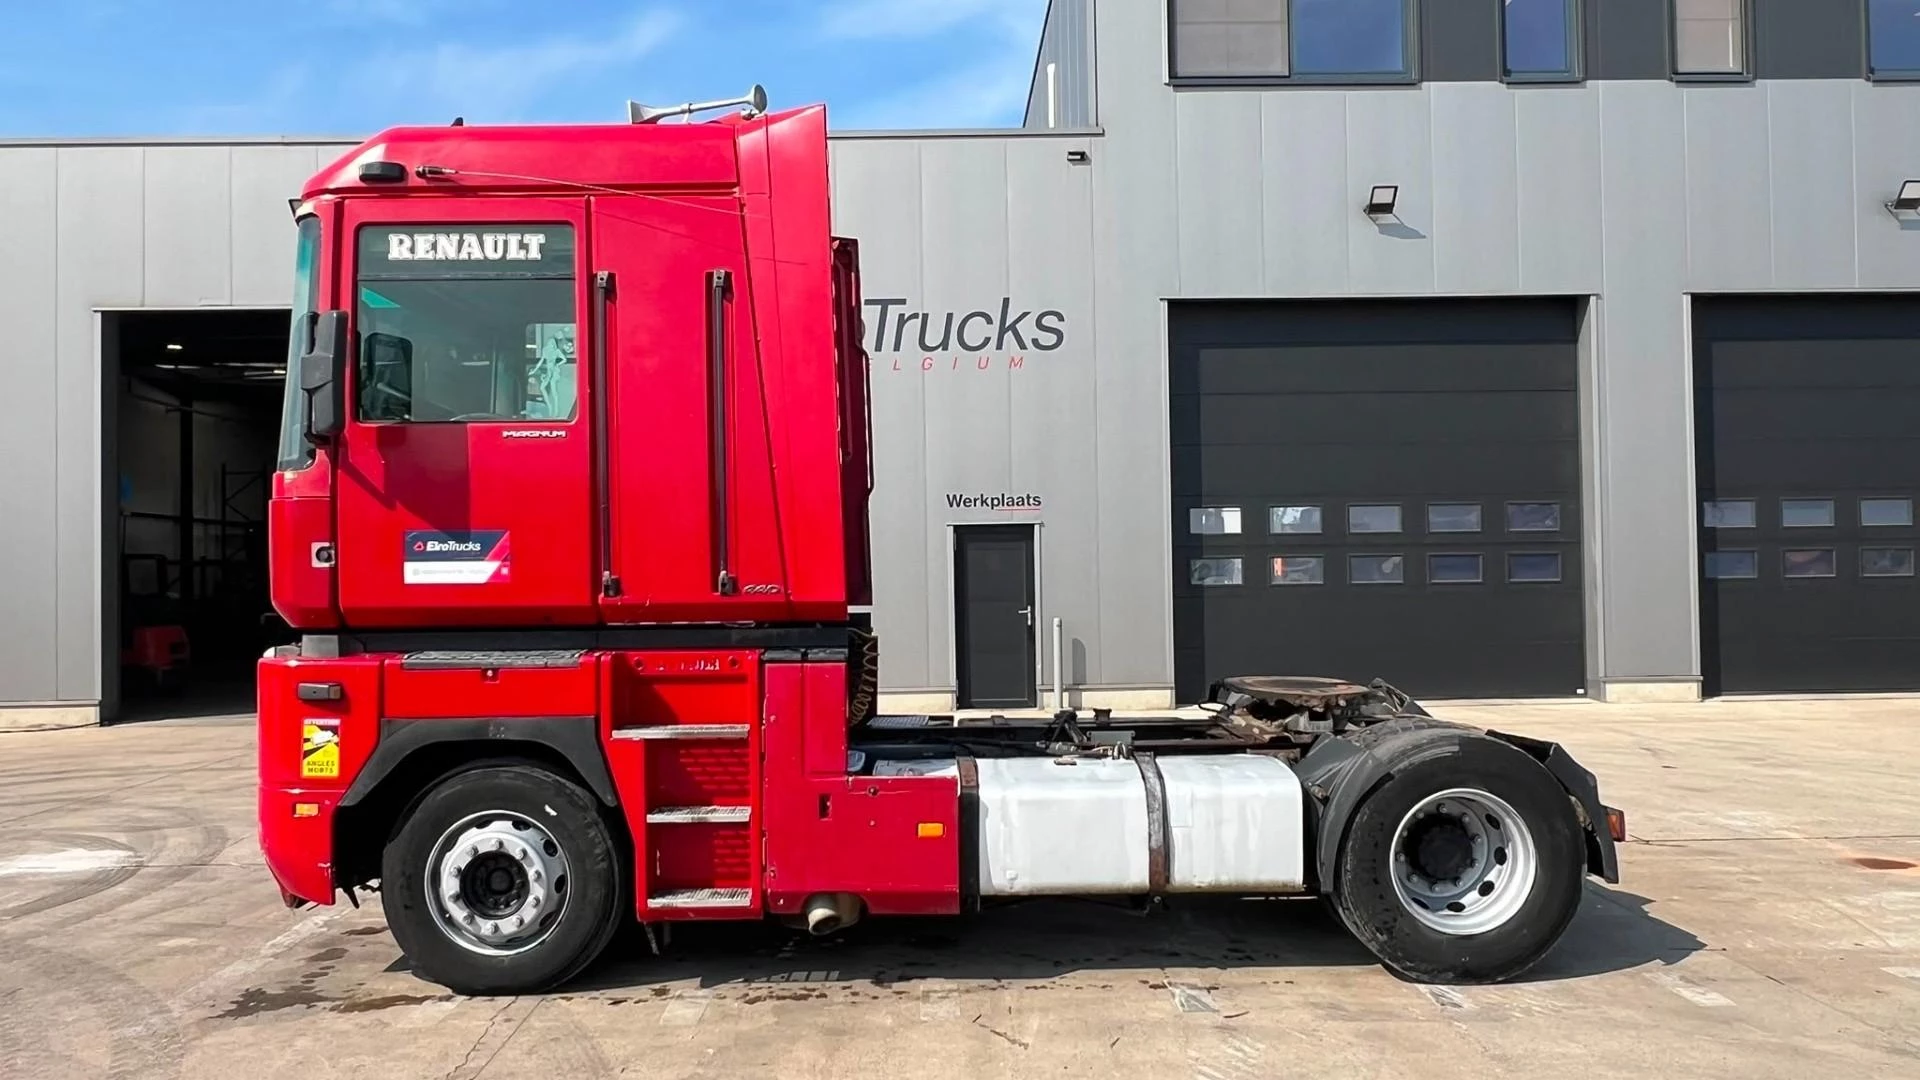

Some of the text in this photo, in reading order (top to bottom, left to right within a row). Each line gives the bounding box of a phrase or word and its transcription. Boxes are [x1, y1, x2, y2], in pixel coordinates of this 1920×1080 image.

[388, 233, 546, 261] RENAULT
[863, 297, 1066, 353] Trucks
[892, 356, 1024, 371] LGIUM
[502, 430, 568, 438] MAGNUM
[946, 493, 1042, 510] Werkplaats
